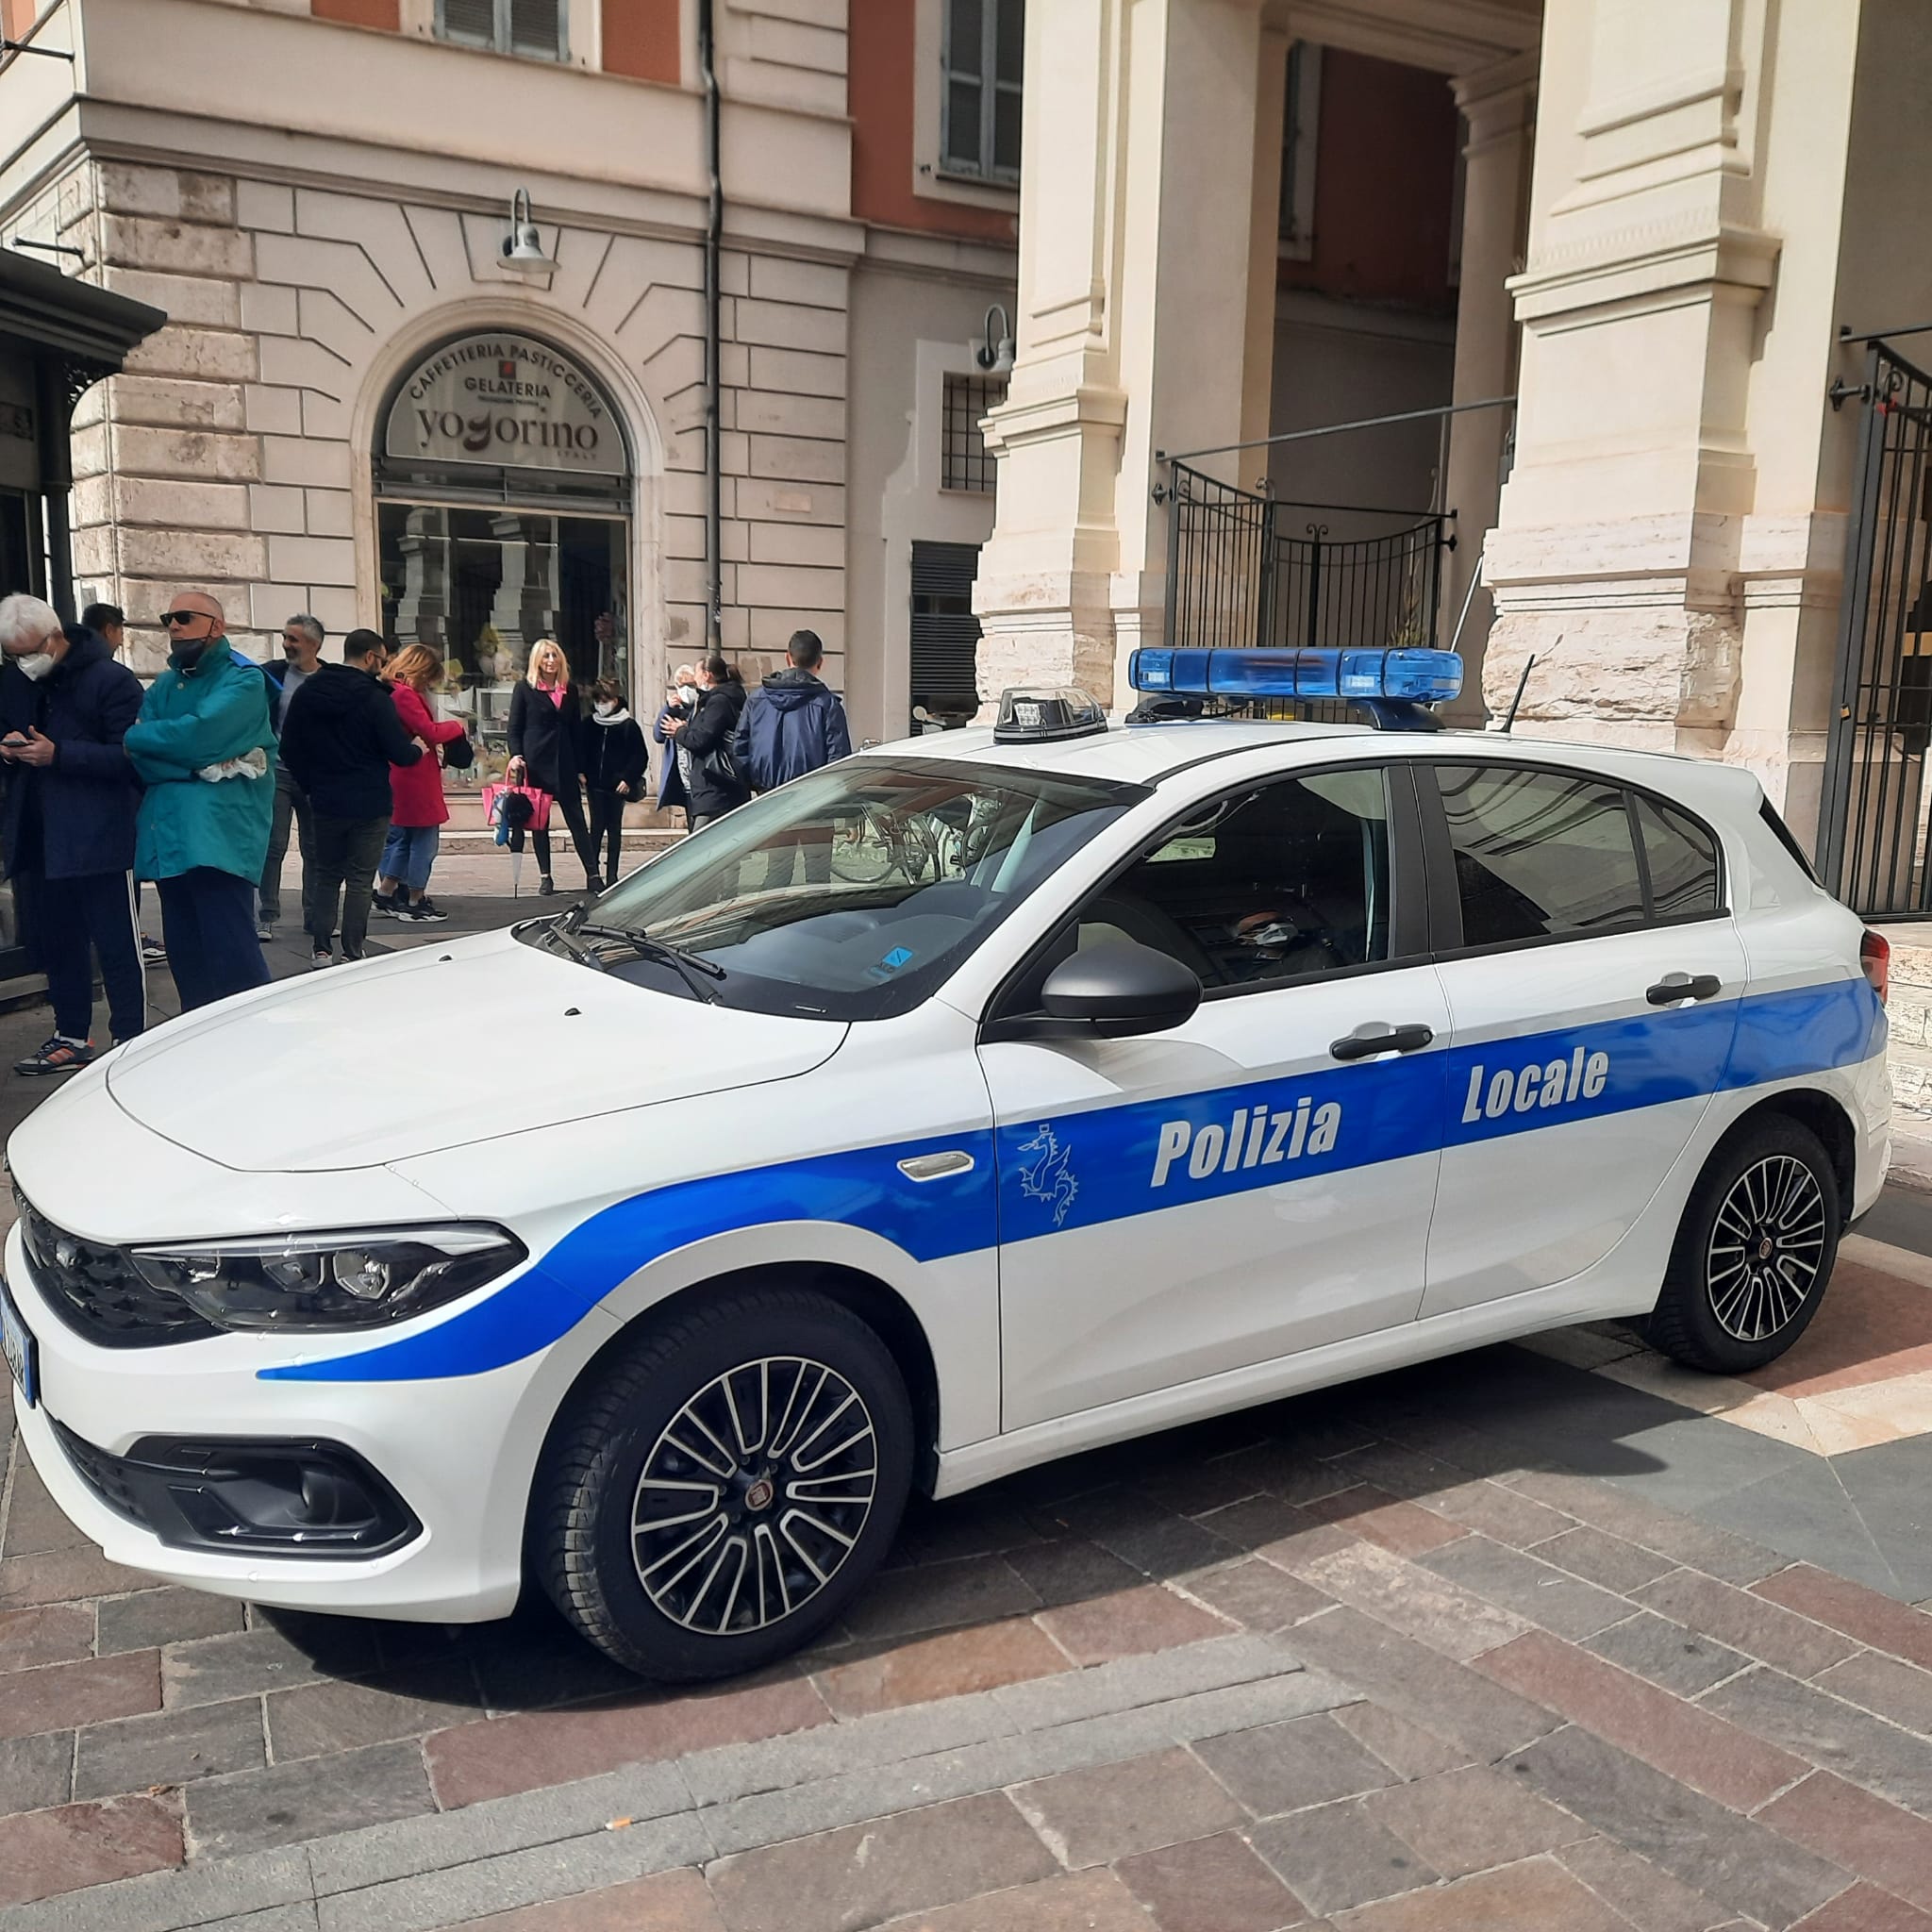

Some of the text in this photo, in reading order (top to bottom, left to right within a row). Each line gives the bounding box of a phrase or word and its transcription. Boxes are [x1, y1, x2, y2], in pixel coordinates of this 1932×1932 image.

[409, 344, 602, 419] CAFFETTERIA PASTICCERIA
[464, 377, 551, 398] GELATERIA
[416, 406, 598, 452] yogorino
[1150, 1046, 1608, 1188] Polizia Locale
